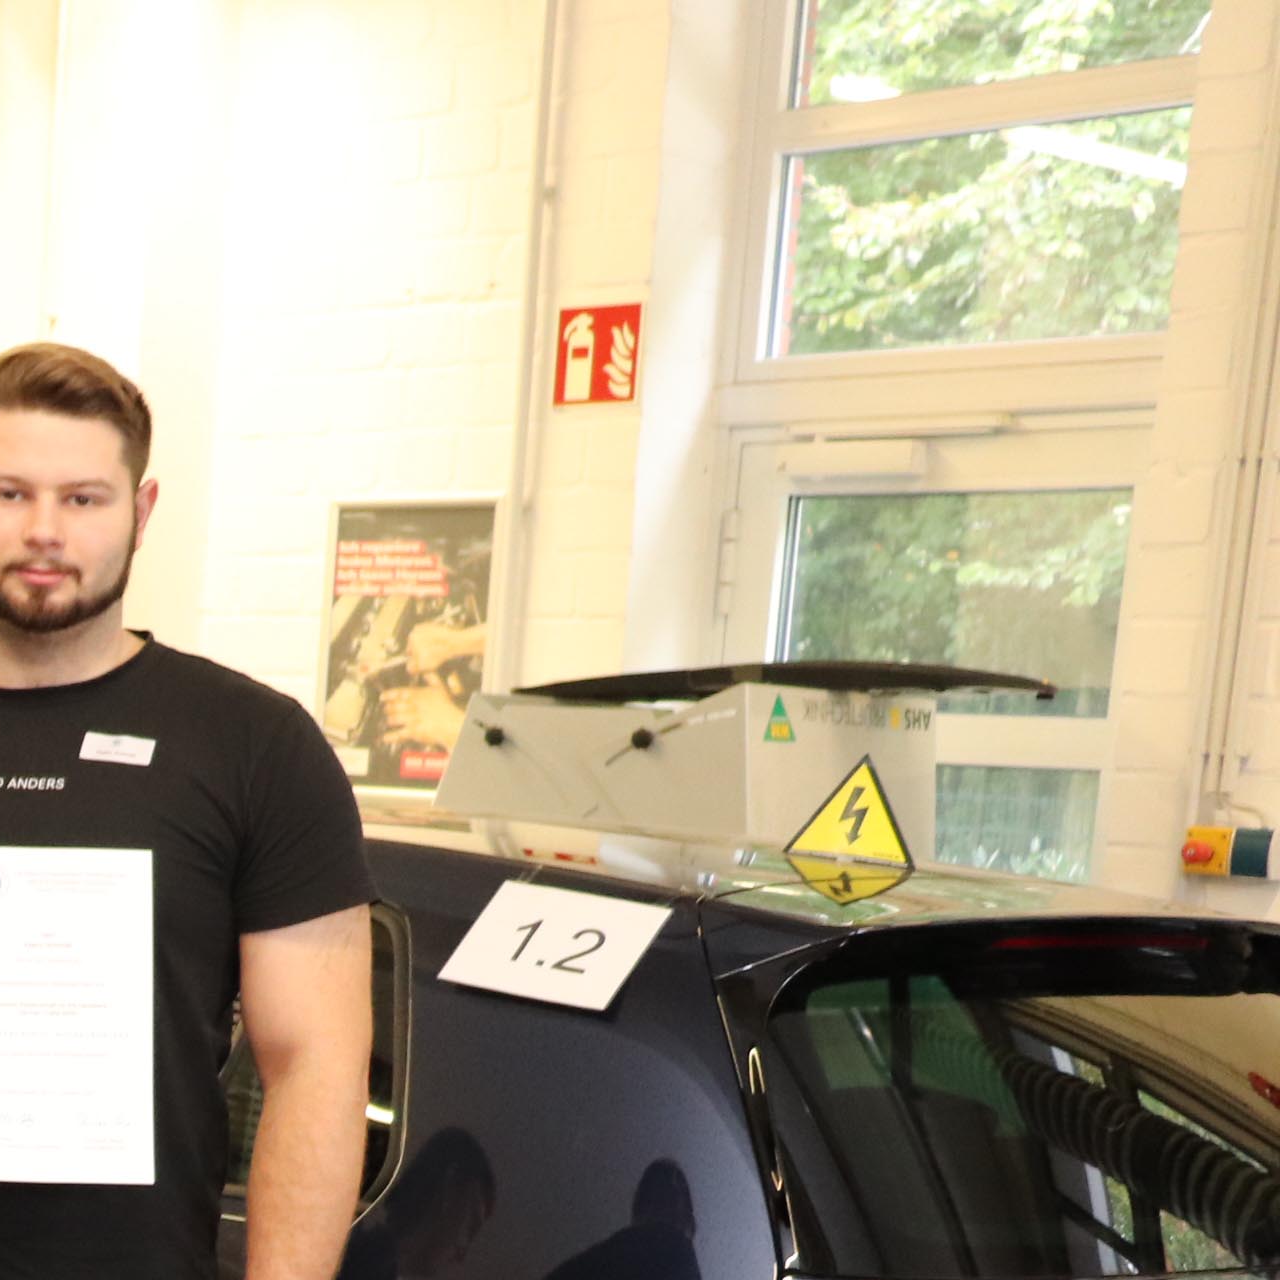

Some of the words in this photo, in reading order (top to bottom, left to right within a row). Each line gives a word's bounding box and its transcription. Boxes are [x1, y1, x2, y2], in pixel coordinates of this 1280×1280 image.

[904, 708, 932, 731] AHS
[6, 777, 66, 791] ANDERS
[510, 919, 606, 974] 1.2
